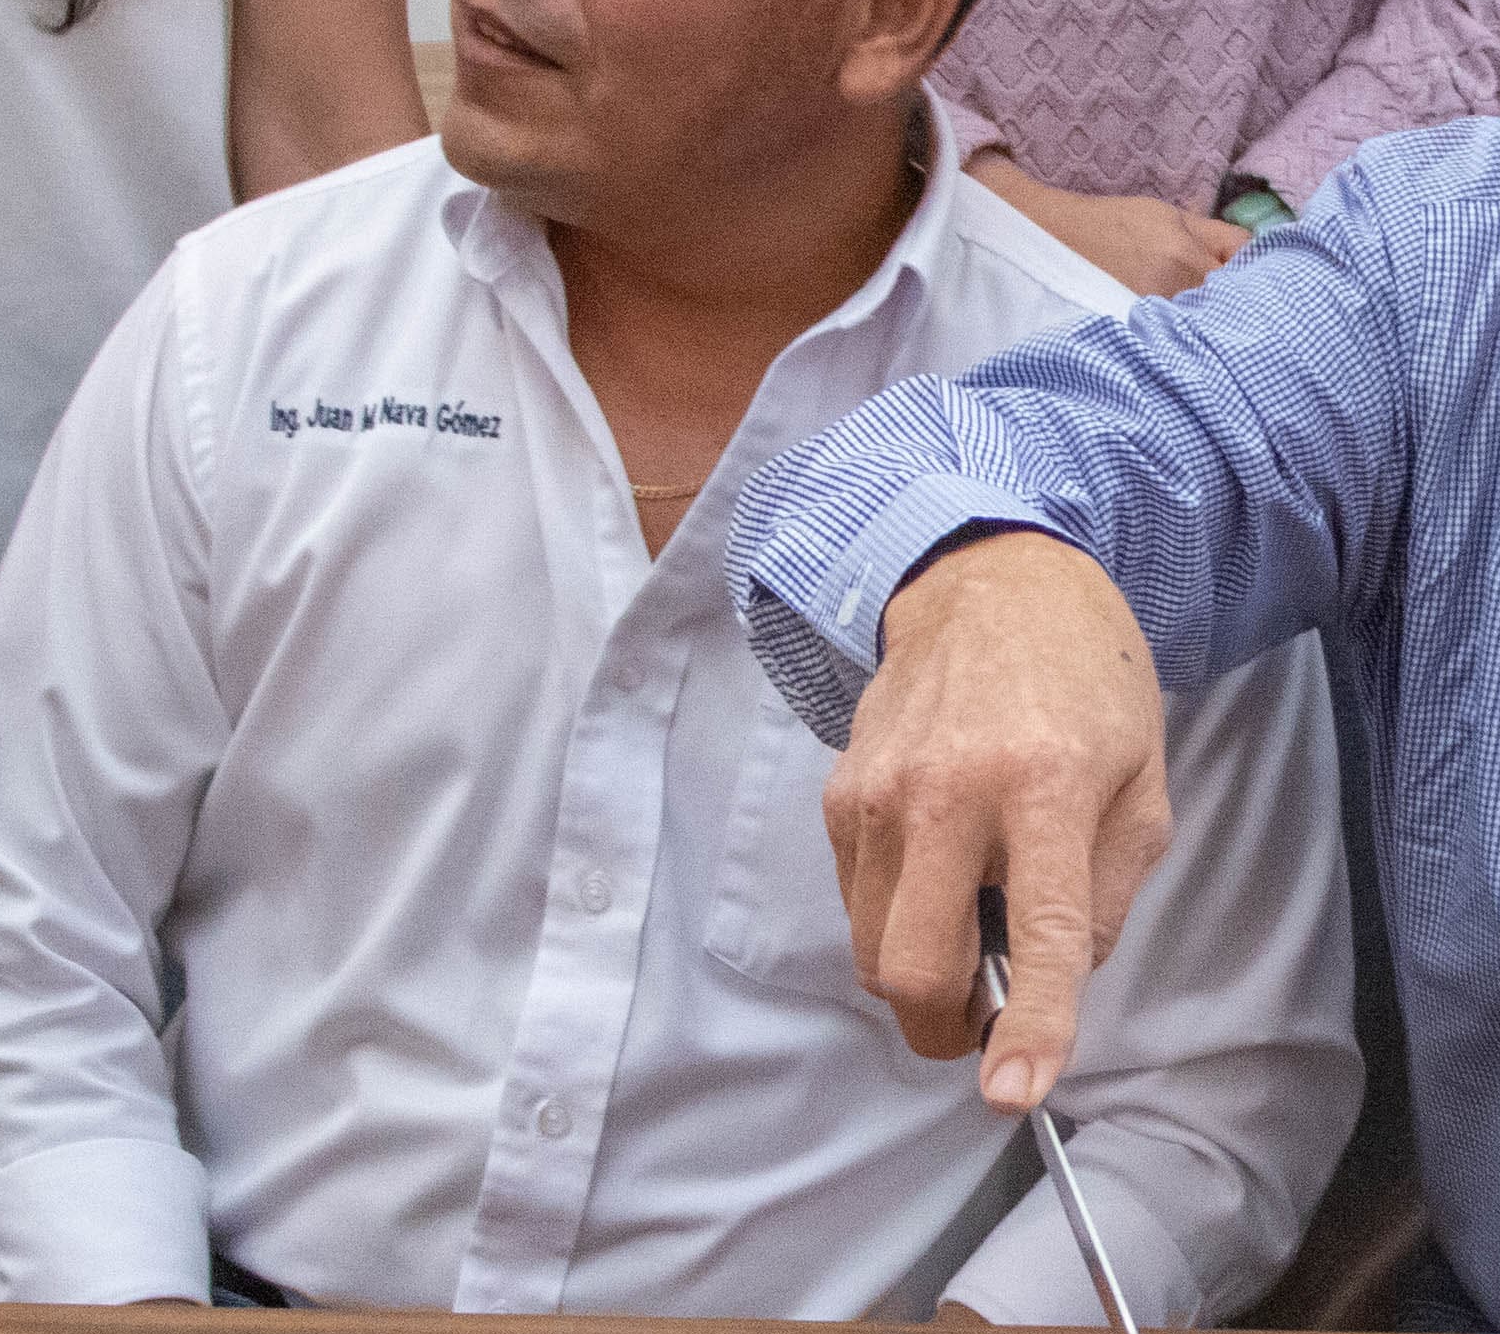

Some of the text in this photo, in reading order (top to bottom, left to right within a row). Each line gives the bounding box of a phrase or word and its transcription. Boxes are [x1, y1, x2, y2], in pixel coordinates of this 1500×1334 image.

[306, 398, 353, 432] Juan
[380, 396, 427, 427] Nava
[436, 400, 502, 438] Gómez
